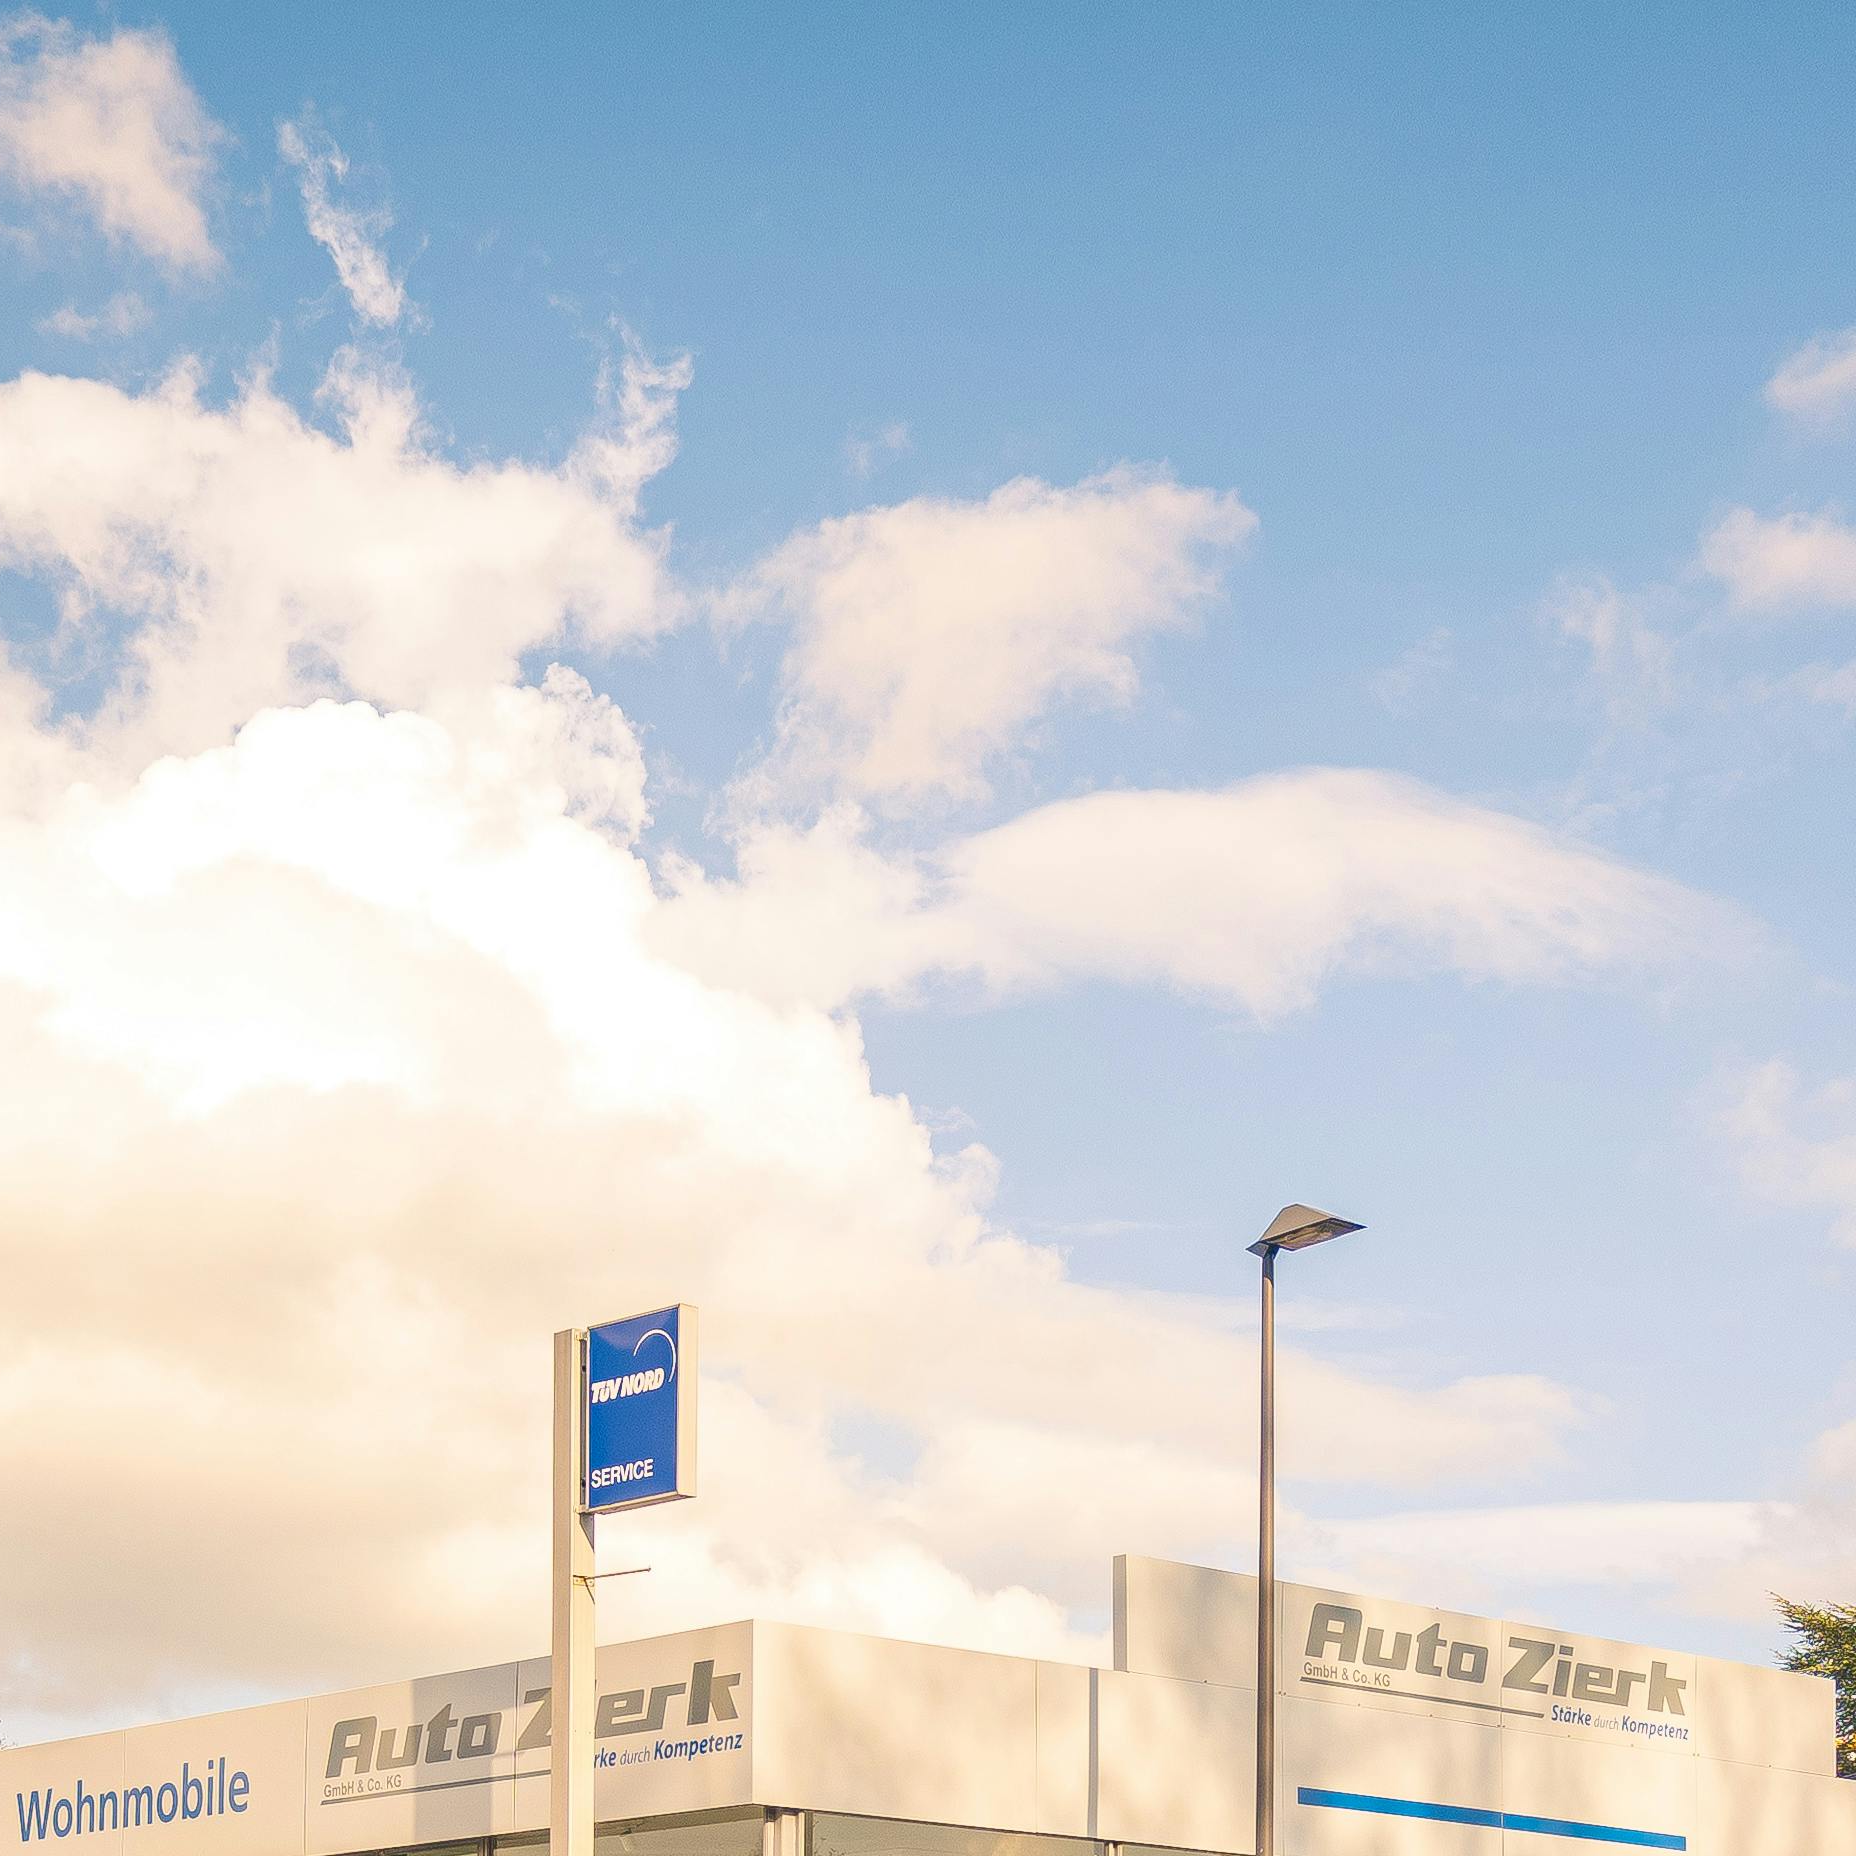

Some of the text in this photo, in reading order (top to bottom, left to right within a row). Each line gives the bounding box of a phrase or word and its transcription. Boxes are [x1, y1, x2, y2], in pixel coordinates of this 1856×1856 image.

[620, 1368, 665, 1398] NORD
[591, 1458, 654, 1489] SERVICE
[1303, 1661, 1391, 1688] GmbH & Co. KG
[1305, 1603, 1687, 1716] Auto Zierk
[325, 1659, 741, 1779] Auto Zerk
[1551, 1704, 1689, 1742] Stärke durch Kompetenz
[594, 1733, 743, 1769] rke durch Kompetenz
[17, 1757, 251, 1843] Wohnmobile
[324, 1774, 402, 1798] GmbH & Co. KG
